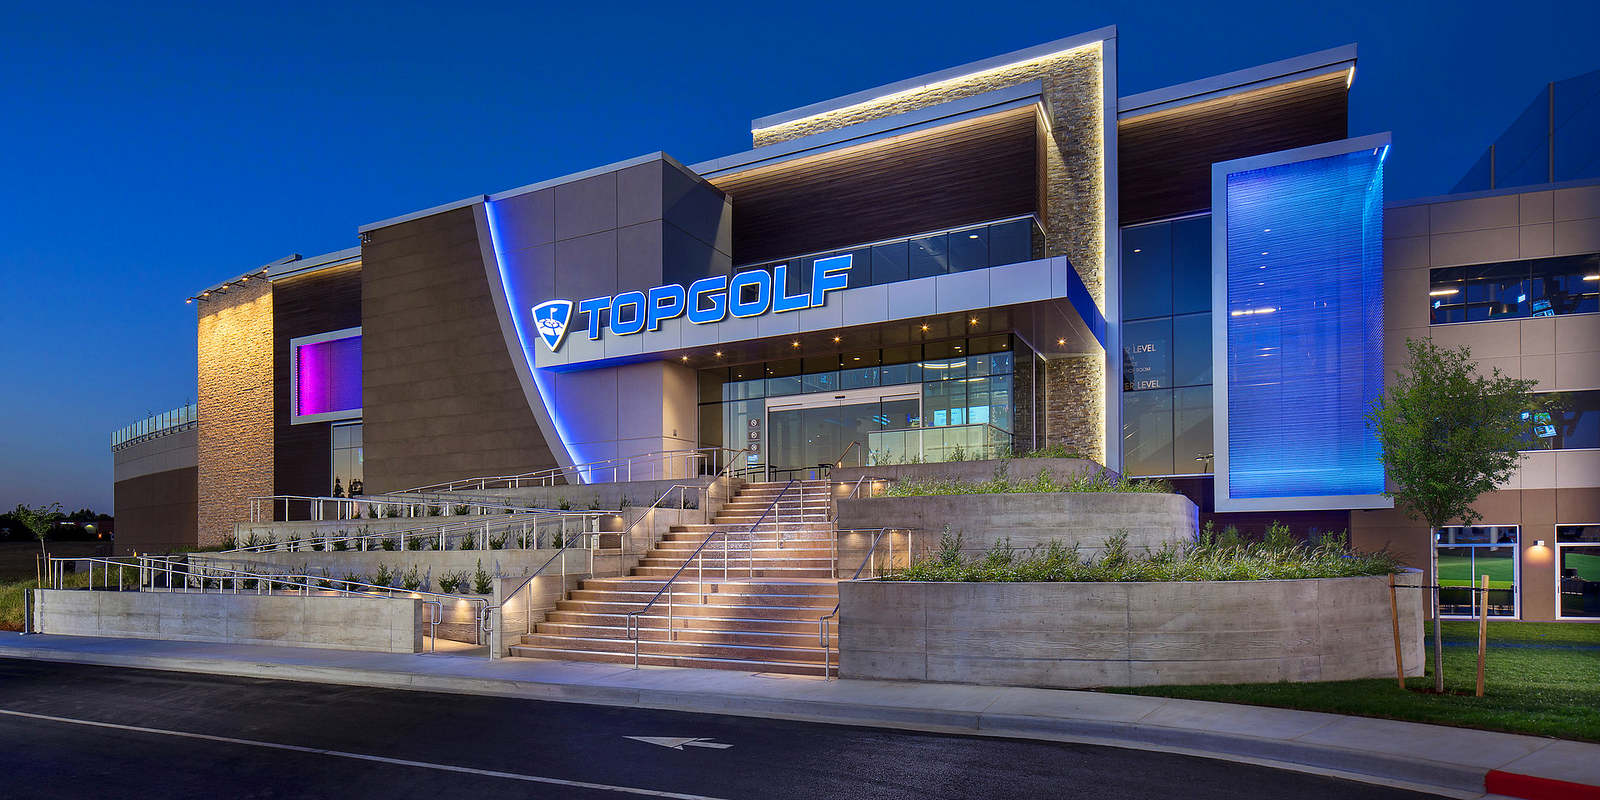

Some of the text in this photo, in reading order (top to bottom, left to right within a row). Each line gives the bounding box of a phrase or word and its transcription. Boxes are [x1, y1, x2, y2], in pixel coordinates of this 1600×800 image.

[579, 254, 853, 340] TOPGOLF
[1133, 344, 1156, 354] LEVEL
[1137, 379, 1160, 389] LEVEL
